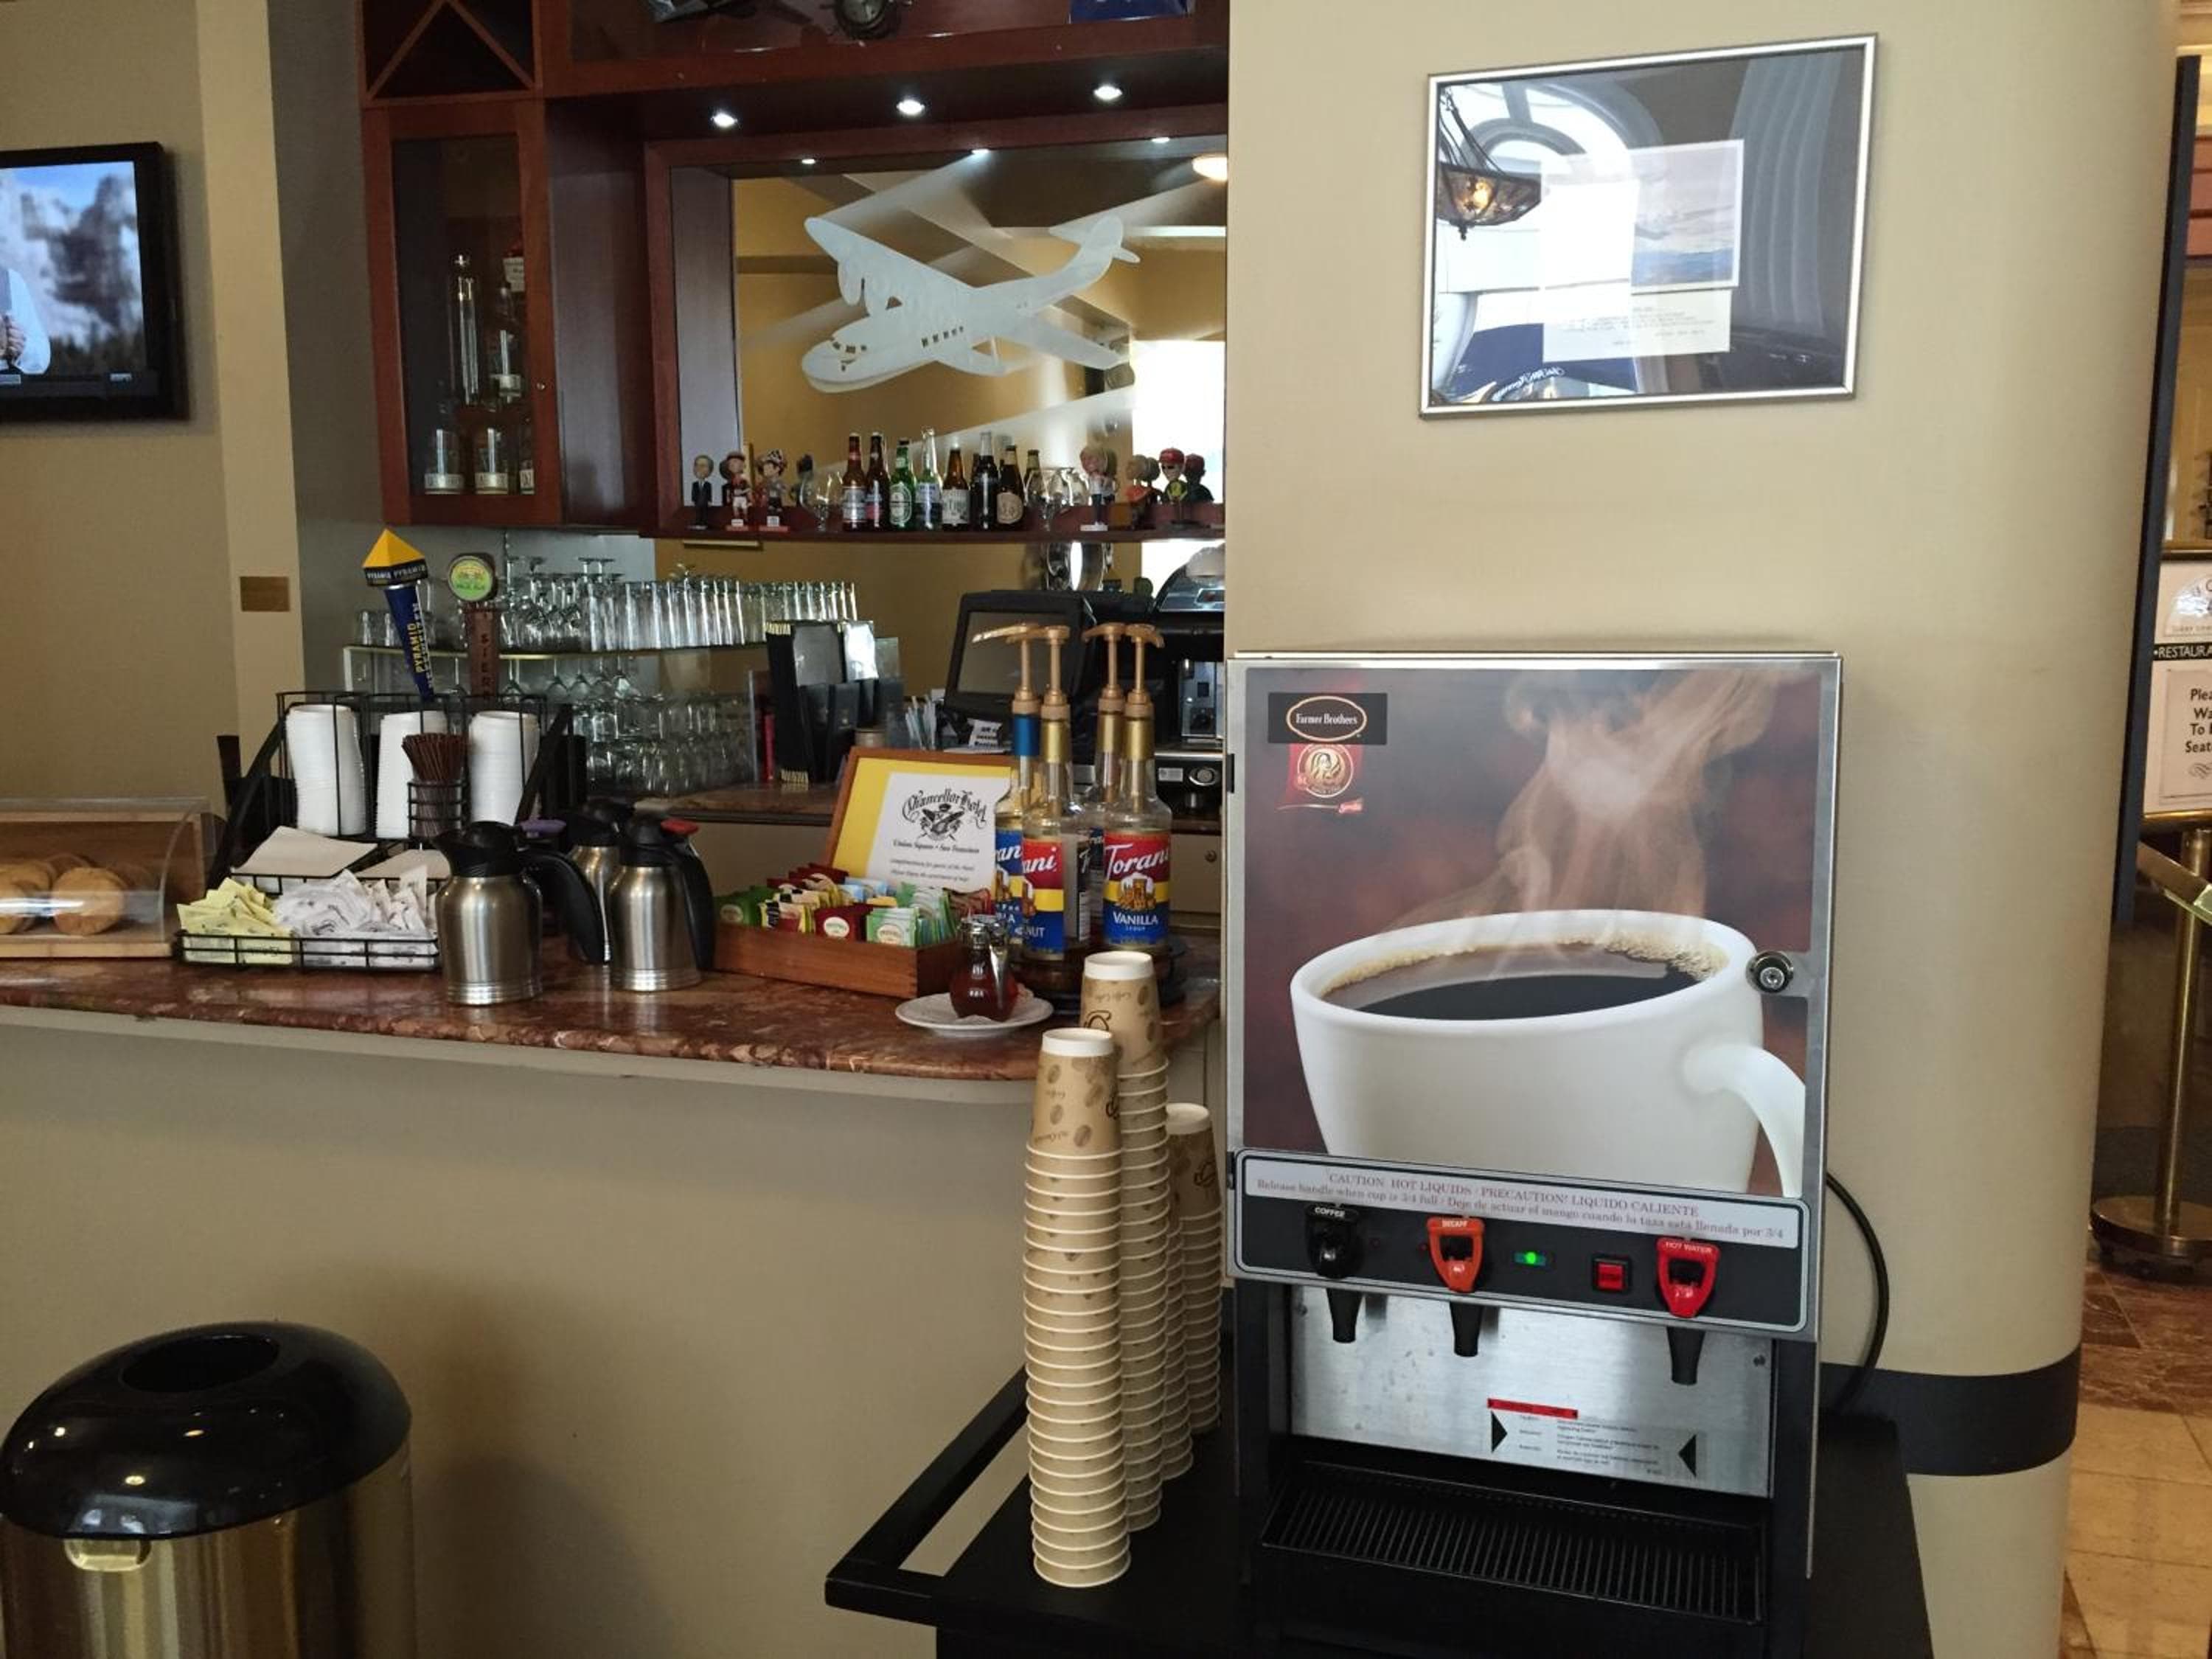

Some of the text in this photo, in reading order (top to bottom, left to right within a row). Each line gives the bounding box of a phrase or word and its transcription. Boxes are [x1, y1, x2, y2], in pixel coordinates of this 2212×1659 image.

[406, 622, 425, 674] PYRAMID
[1295, 713, 1358, 726] Farmer Brothers
[2189, 722, 2206, 736] To
[2185, 740, 2212, 754] Seat
[902, 787, 961, 824] Chancellor
[1022, 846, 1057, 874] ani
[1112, 911, 1159, 925] VANILLA
[1391, 1178, 1417, 1191] HOT
[1419, 1181, 1472, 1195] LIQUIDS
[1571, 1195, 1628, 1210] LIQUIDO
[1631, 1200, 1699, 1217] CALIENTE
[1314, 1206, 1346, 1218] COFFEE
[1367, 1191, 1386, 1203] cup
[1582, 1211, 1623, 1224] cuando
[1695, 1220, 1739, 1235] llenada
[1742, 1227, 1762, 1239] por
[1763, 1228, 1784, 1239] 3/4
[1665, 1241, 1713, 1253] HOT WATER
